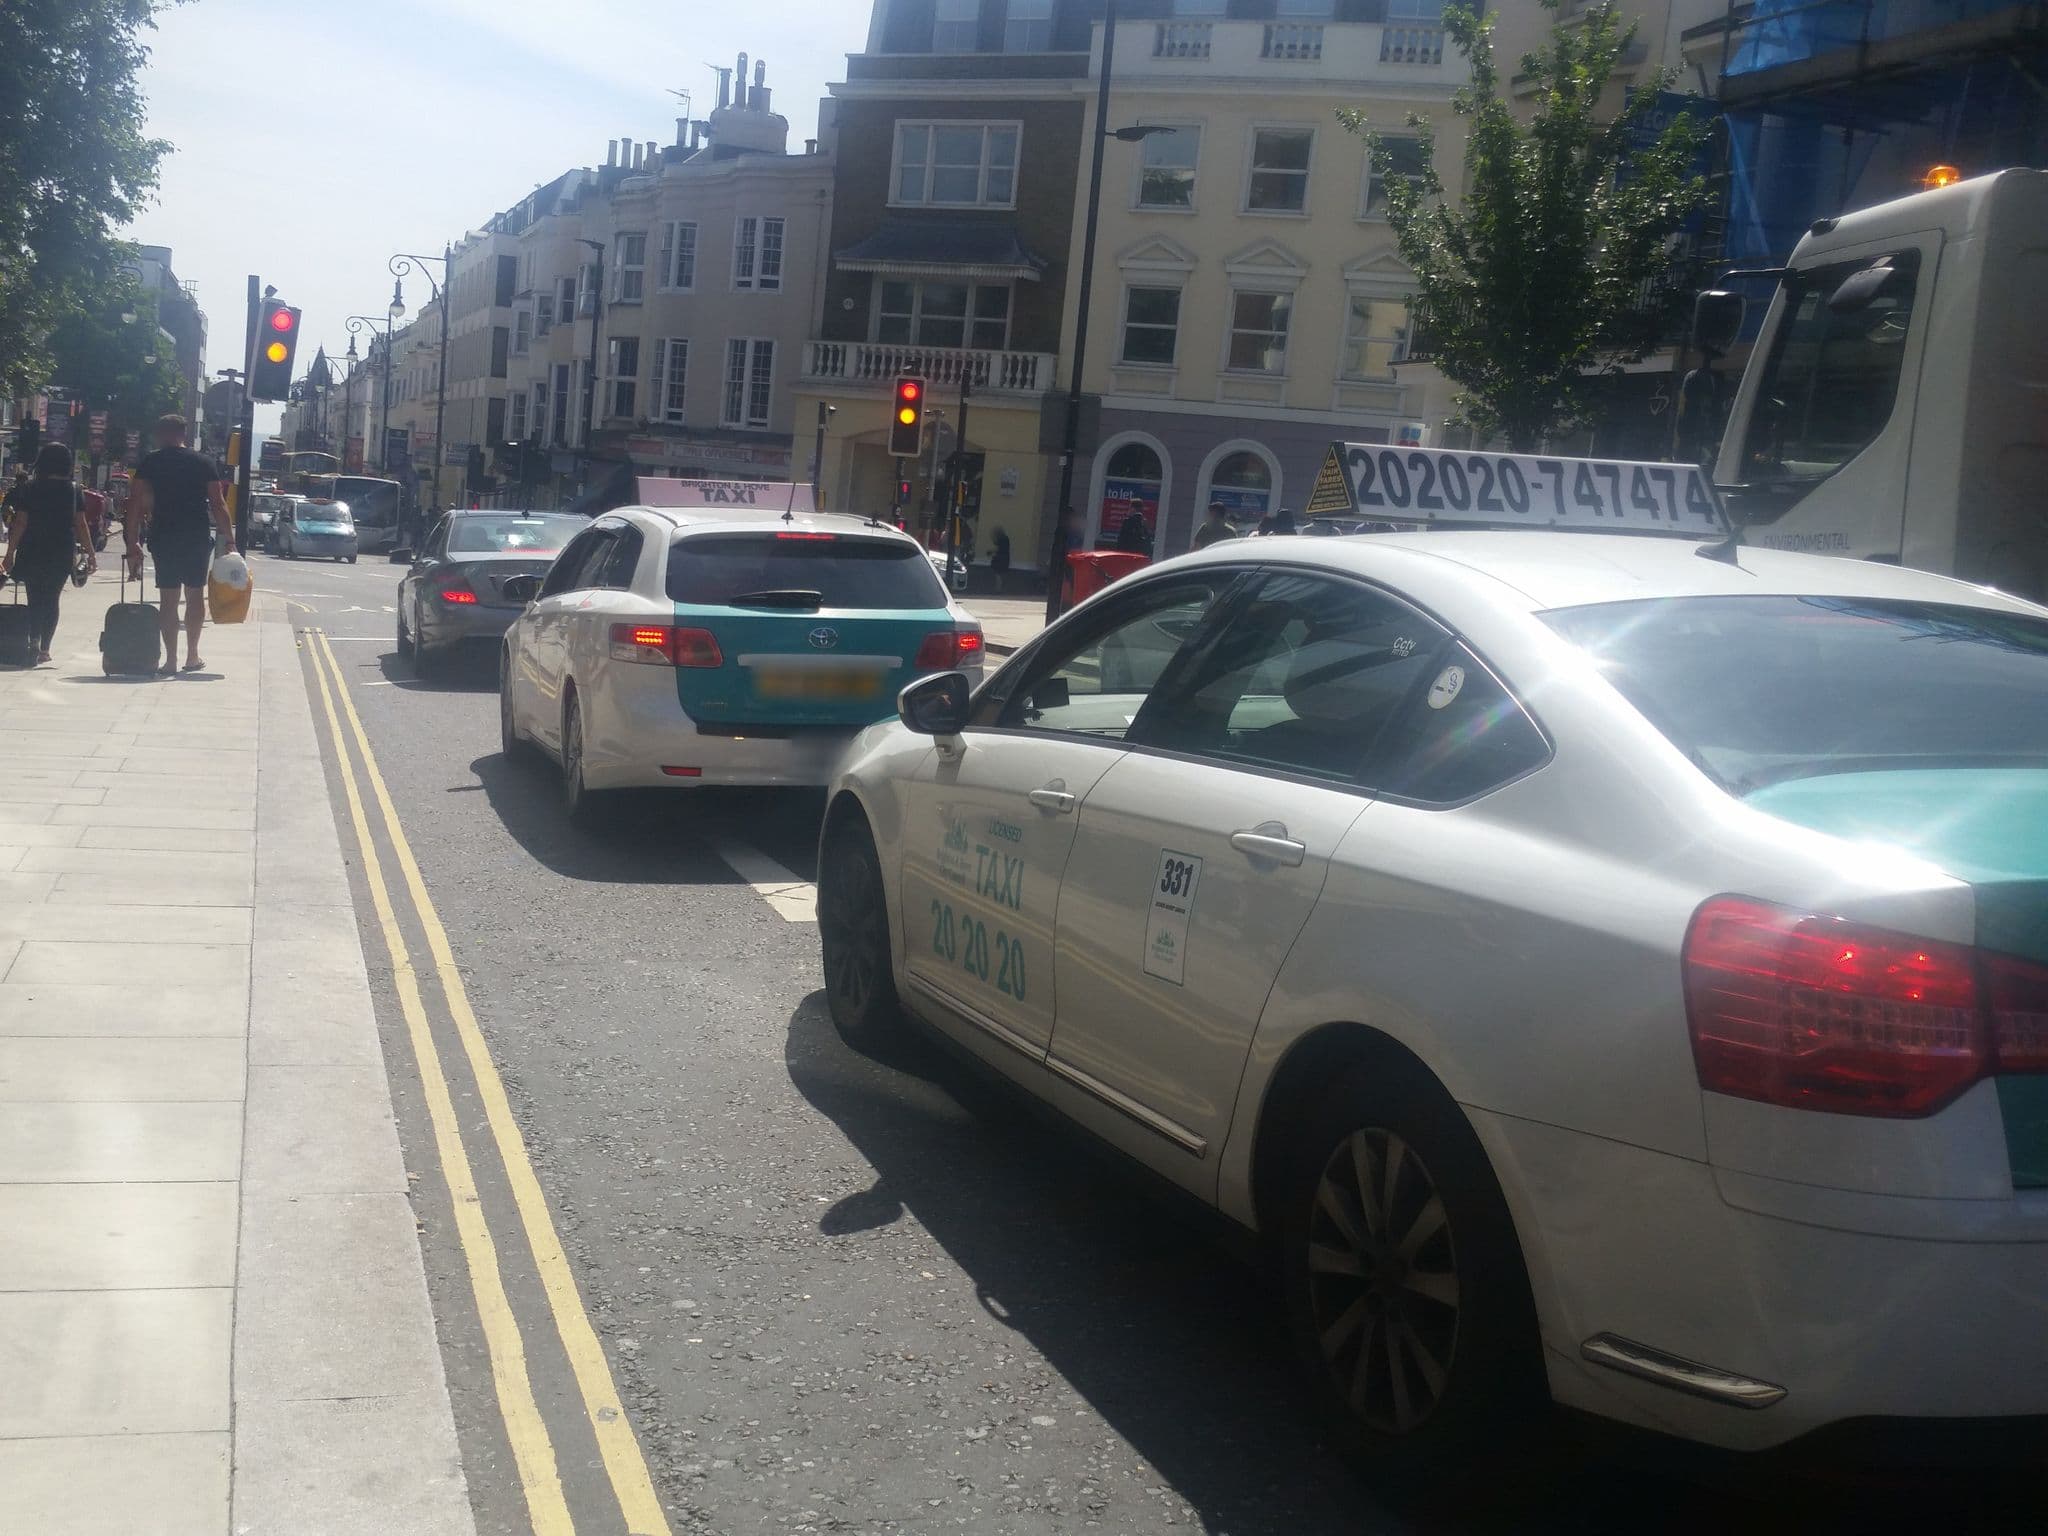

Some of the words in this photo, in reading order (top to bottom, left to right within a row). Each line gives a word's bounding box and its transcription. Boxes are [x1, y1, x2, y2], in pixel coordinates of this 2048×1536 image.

[699, 489, 756, 504] TAXI
[1107, 488, 1119, 499] to
[1120, 488, 1134, 500] let
[1349, 448, 1714, 525] 202020-747474
[1763, 532, 1851, 551] ENVIRONMENTAL
[989, 818, 1022, 842] LICENSED
[975, 843, 1025, 912] TAXI
[1160, 858, 1194, 898] 331
[931, 897, 956, 962] 20
[961, 914, 989, 982] 20
[996, 929, 1026, 1003] 20
